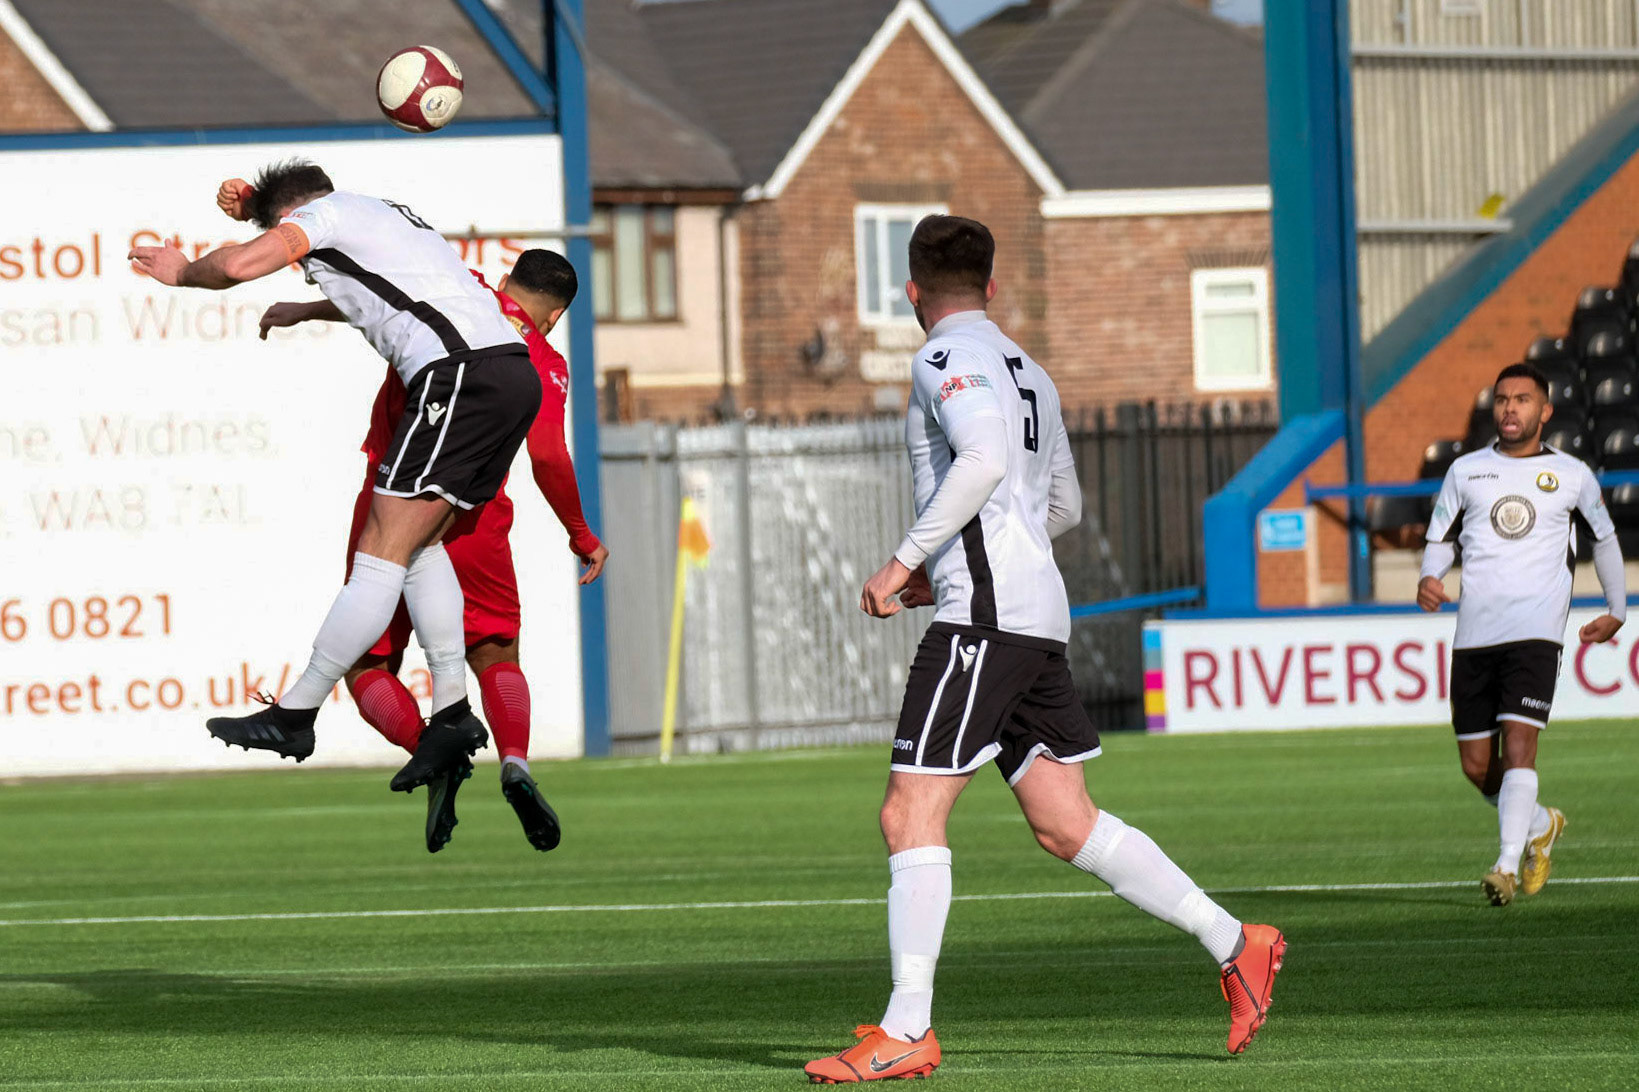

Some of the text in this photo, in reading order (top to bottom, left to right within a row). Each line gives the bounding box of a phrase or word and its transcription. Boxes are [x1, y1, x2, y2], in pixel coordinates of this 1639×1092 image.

[1002, 352, 1038, 454] 5
[0, 592, 170, 641] 6 0821
[1183, 638, 1449, 711] RIVERSI
